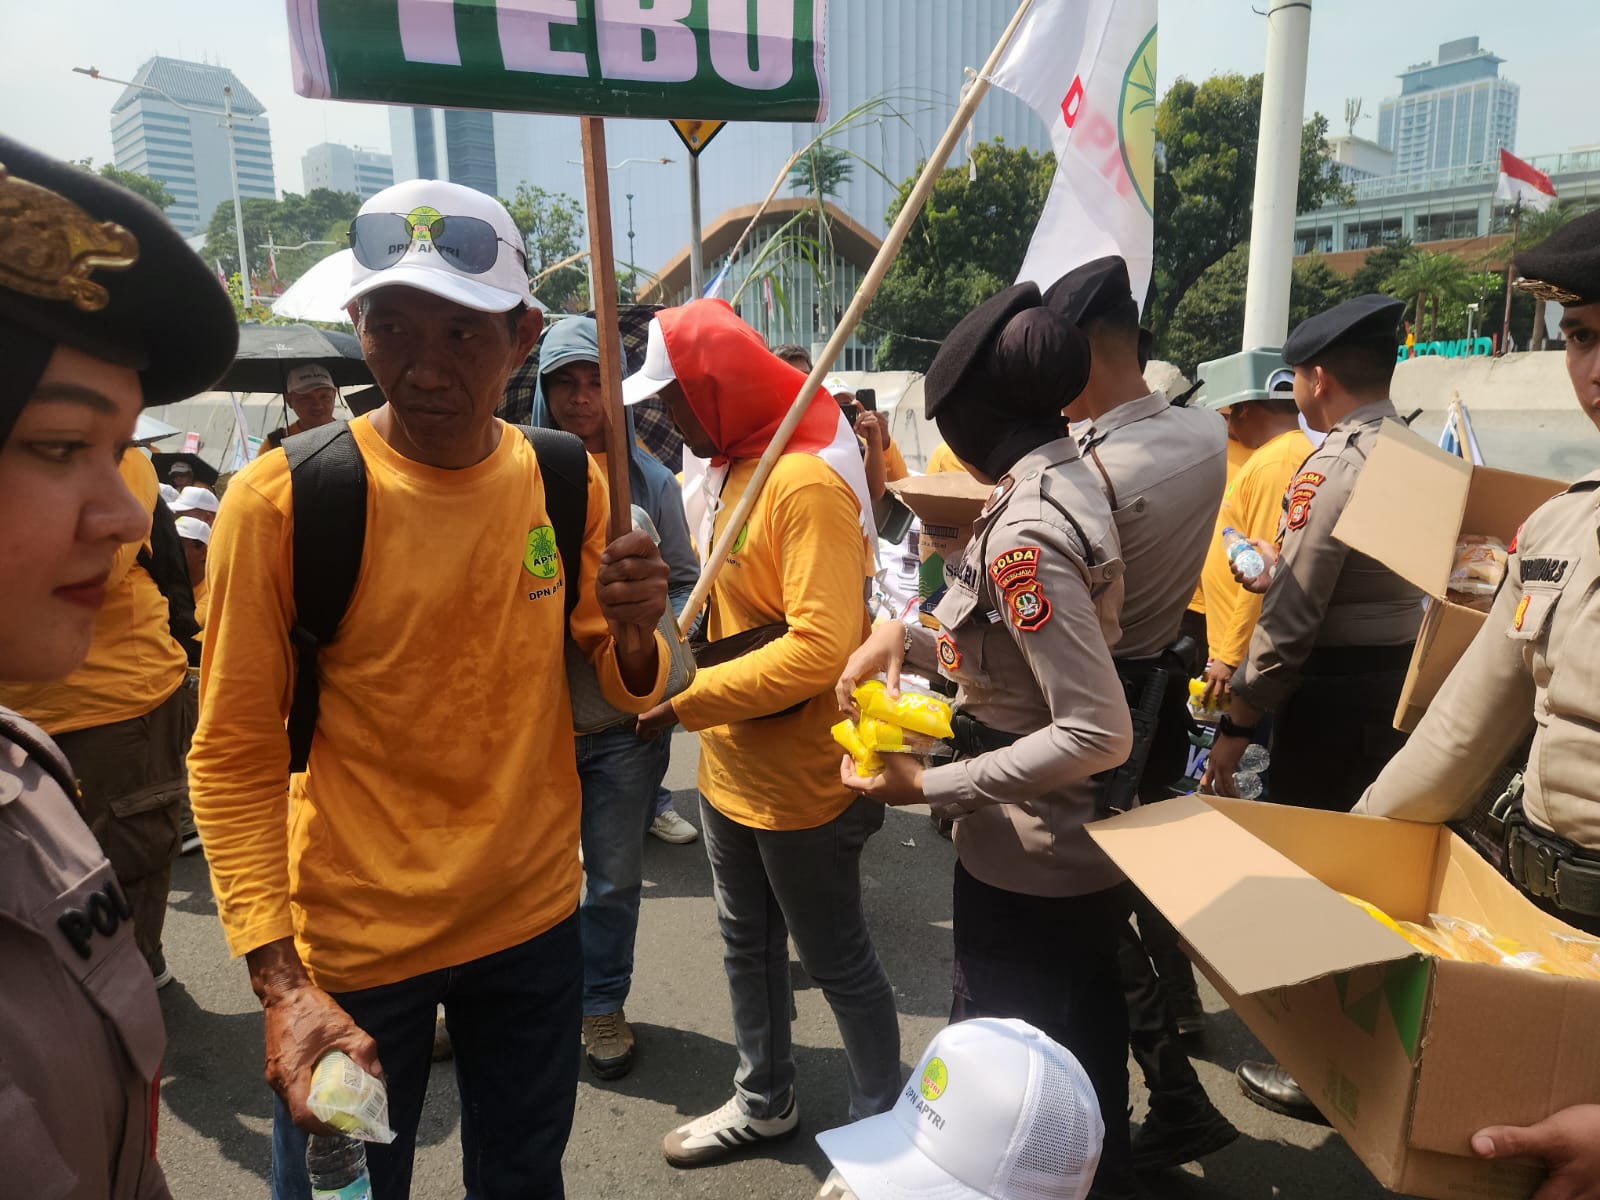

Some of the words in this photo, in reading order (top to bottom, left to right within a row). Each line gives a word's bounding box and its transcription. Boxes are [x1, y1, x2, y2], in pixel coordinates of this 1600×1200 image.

[992, 550, 1034, 574] POLDA
[528, 587, 551, 601] DPN
[915, 1100, 946, 1131] APTRI
